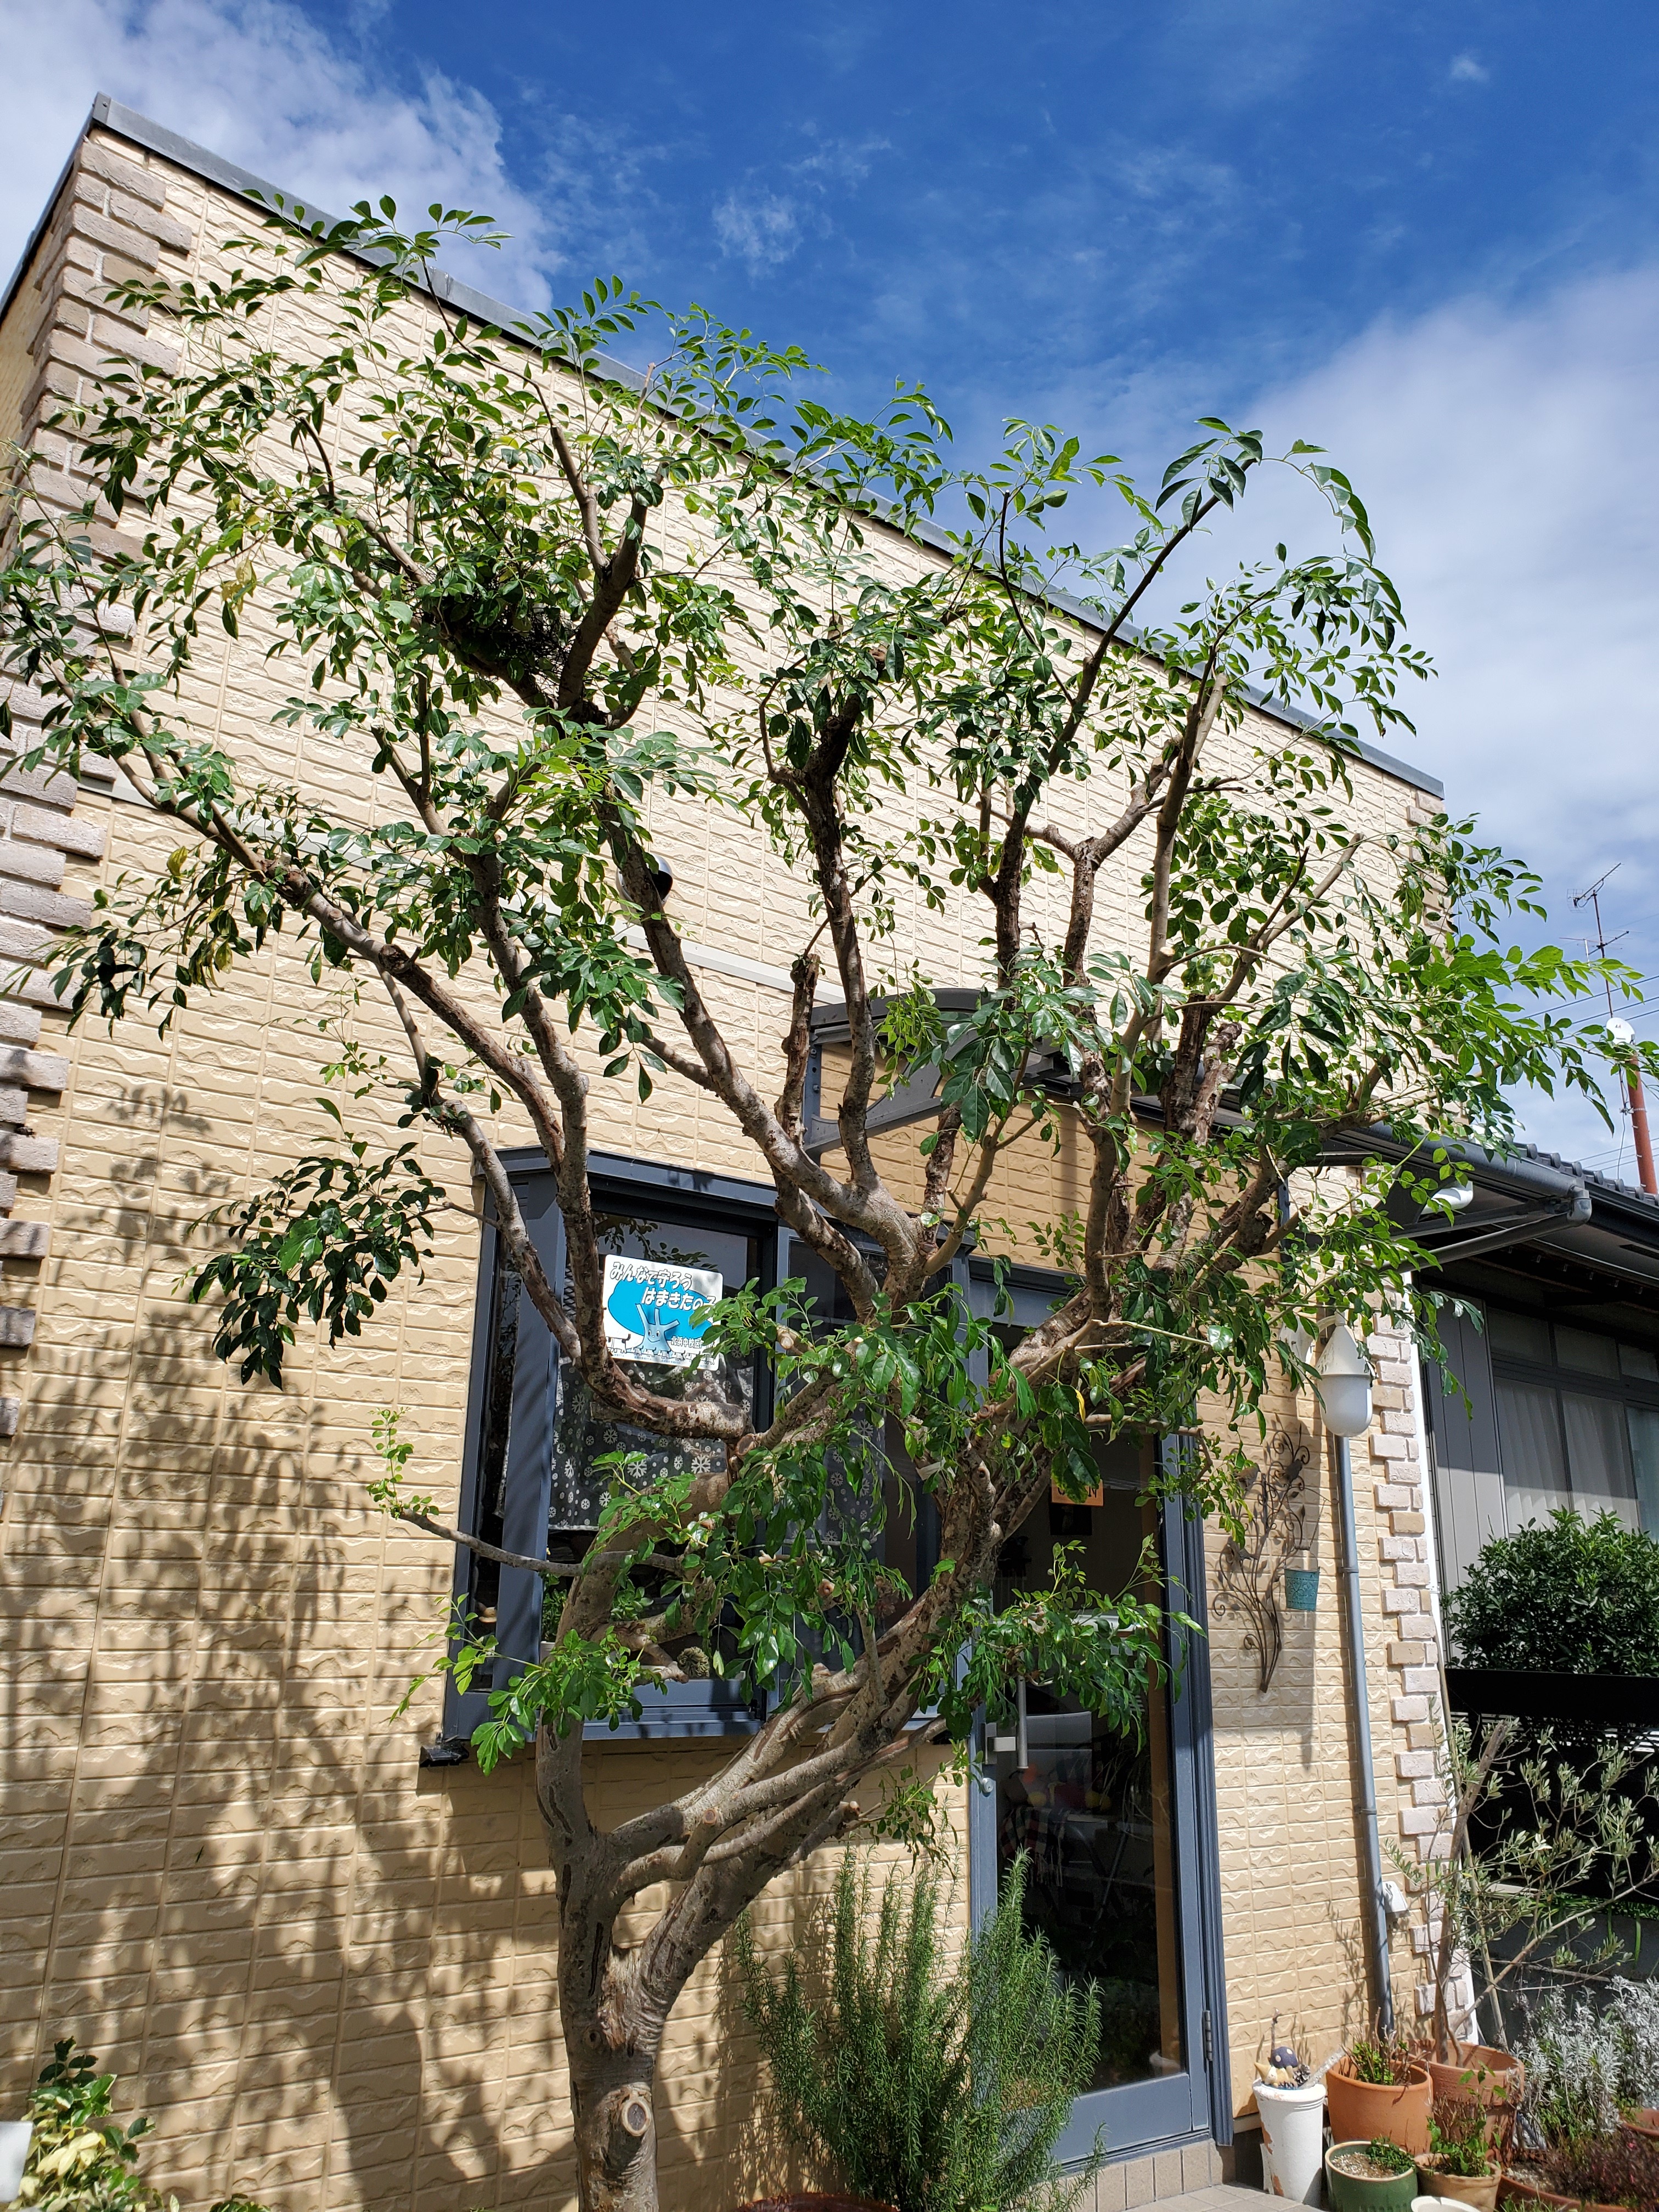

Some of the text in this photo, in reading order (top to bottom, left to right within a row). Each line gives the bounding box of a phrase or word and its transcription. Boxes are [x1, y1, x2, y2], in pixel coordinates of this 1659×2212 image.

[610, 1261, 692, 1291] みんなで守ろう
